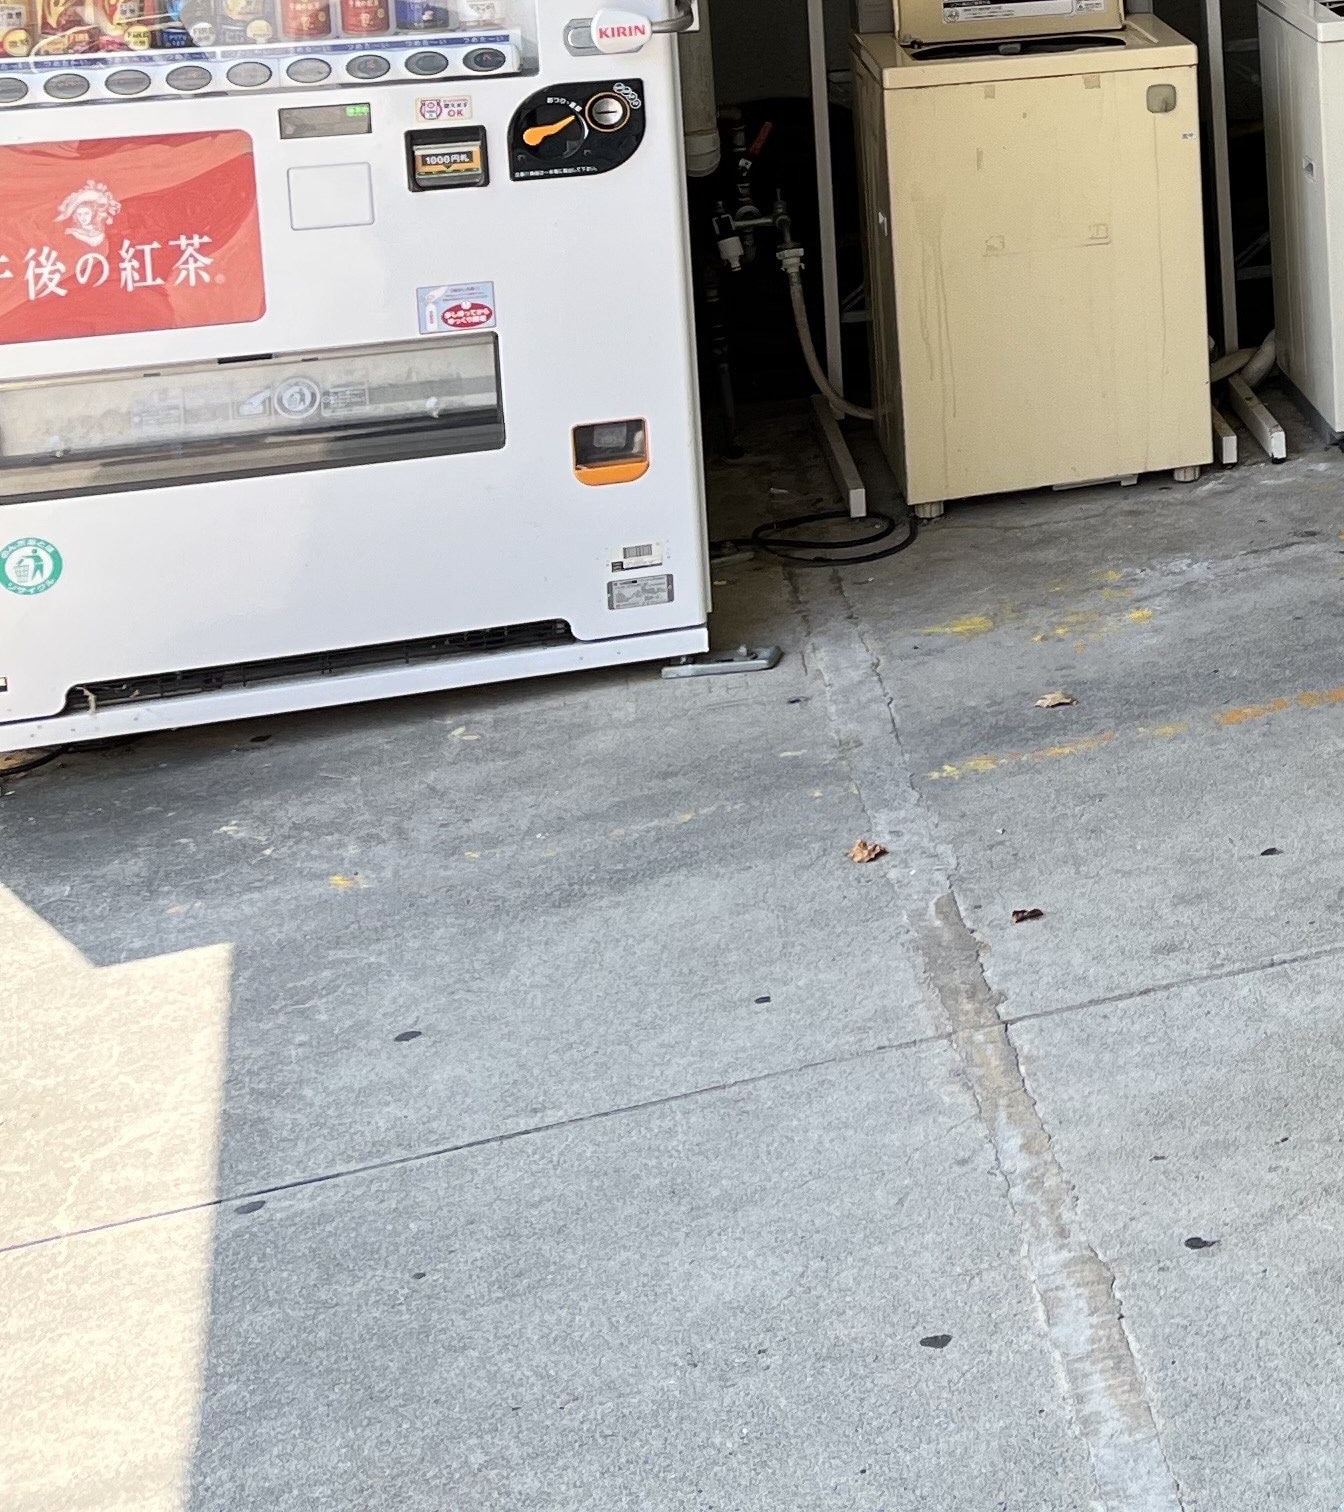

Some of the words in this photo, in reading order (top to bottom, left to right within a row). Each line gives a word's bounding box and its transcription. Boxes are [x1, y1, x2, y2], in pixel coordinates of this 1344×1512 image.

[599, 25, 646, 39] KIRIN
[447, 109, 464, 117] OK
[425, 154, 470, 165] 1000円札
